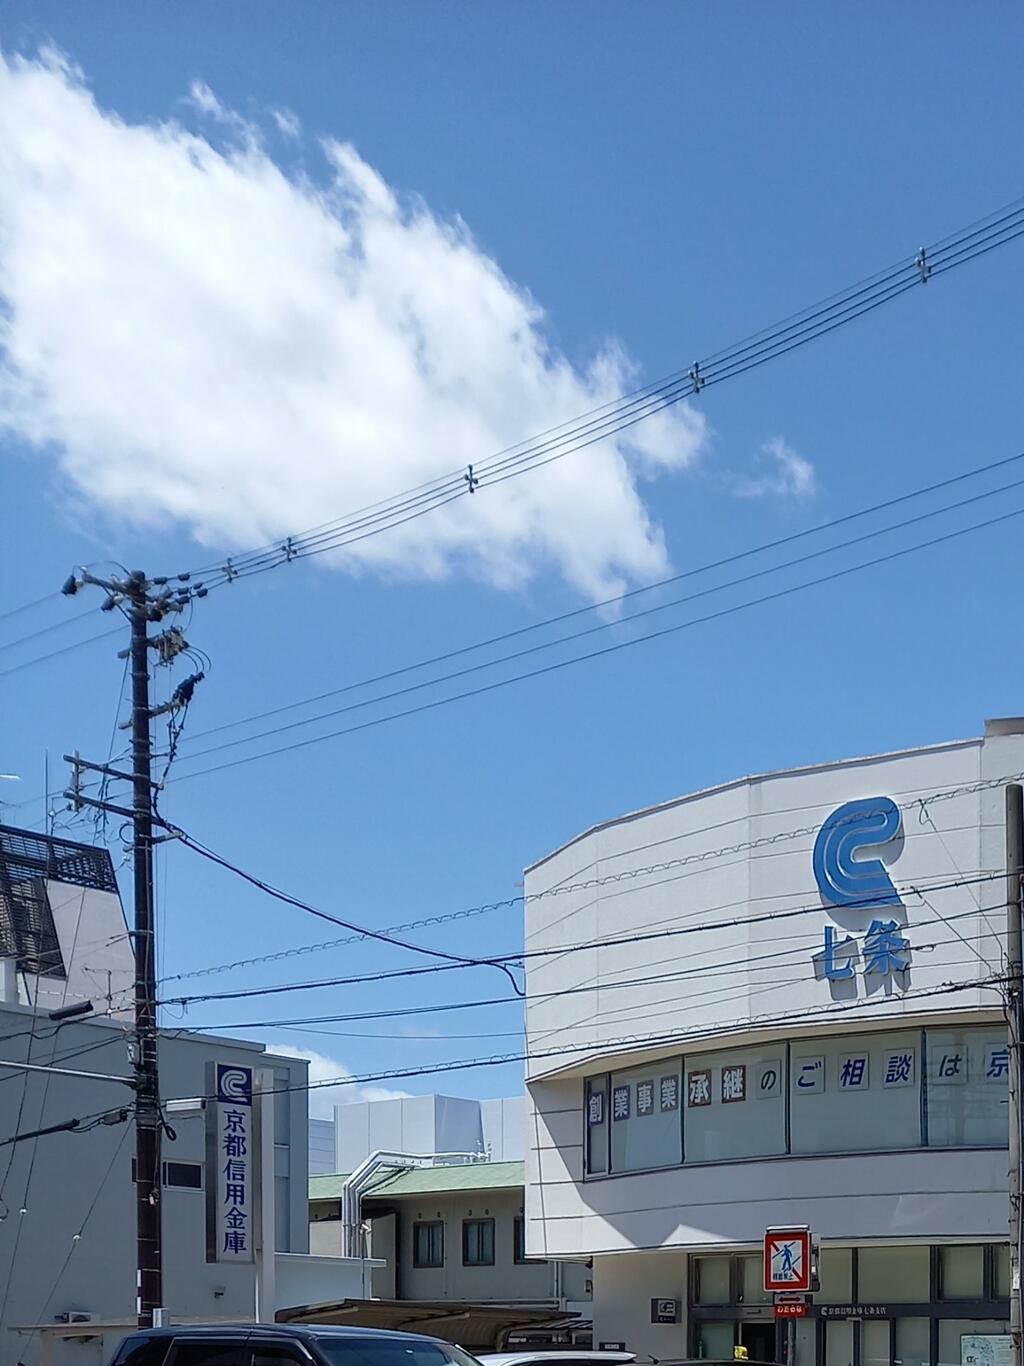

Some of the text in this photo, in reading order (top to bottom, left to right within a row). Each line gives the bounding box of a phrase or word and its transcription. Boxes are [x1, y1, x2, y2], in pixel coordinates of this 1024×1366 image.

[811, 919, 911, 977] 七条
[222, 1109, 248, 1255] 京都信用金庫
